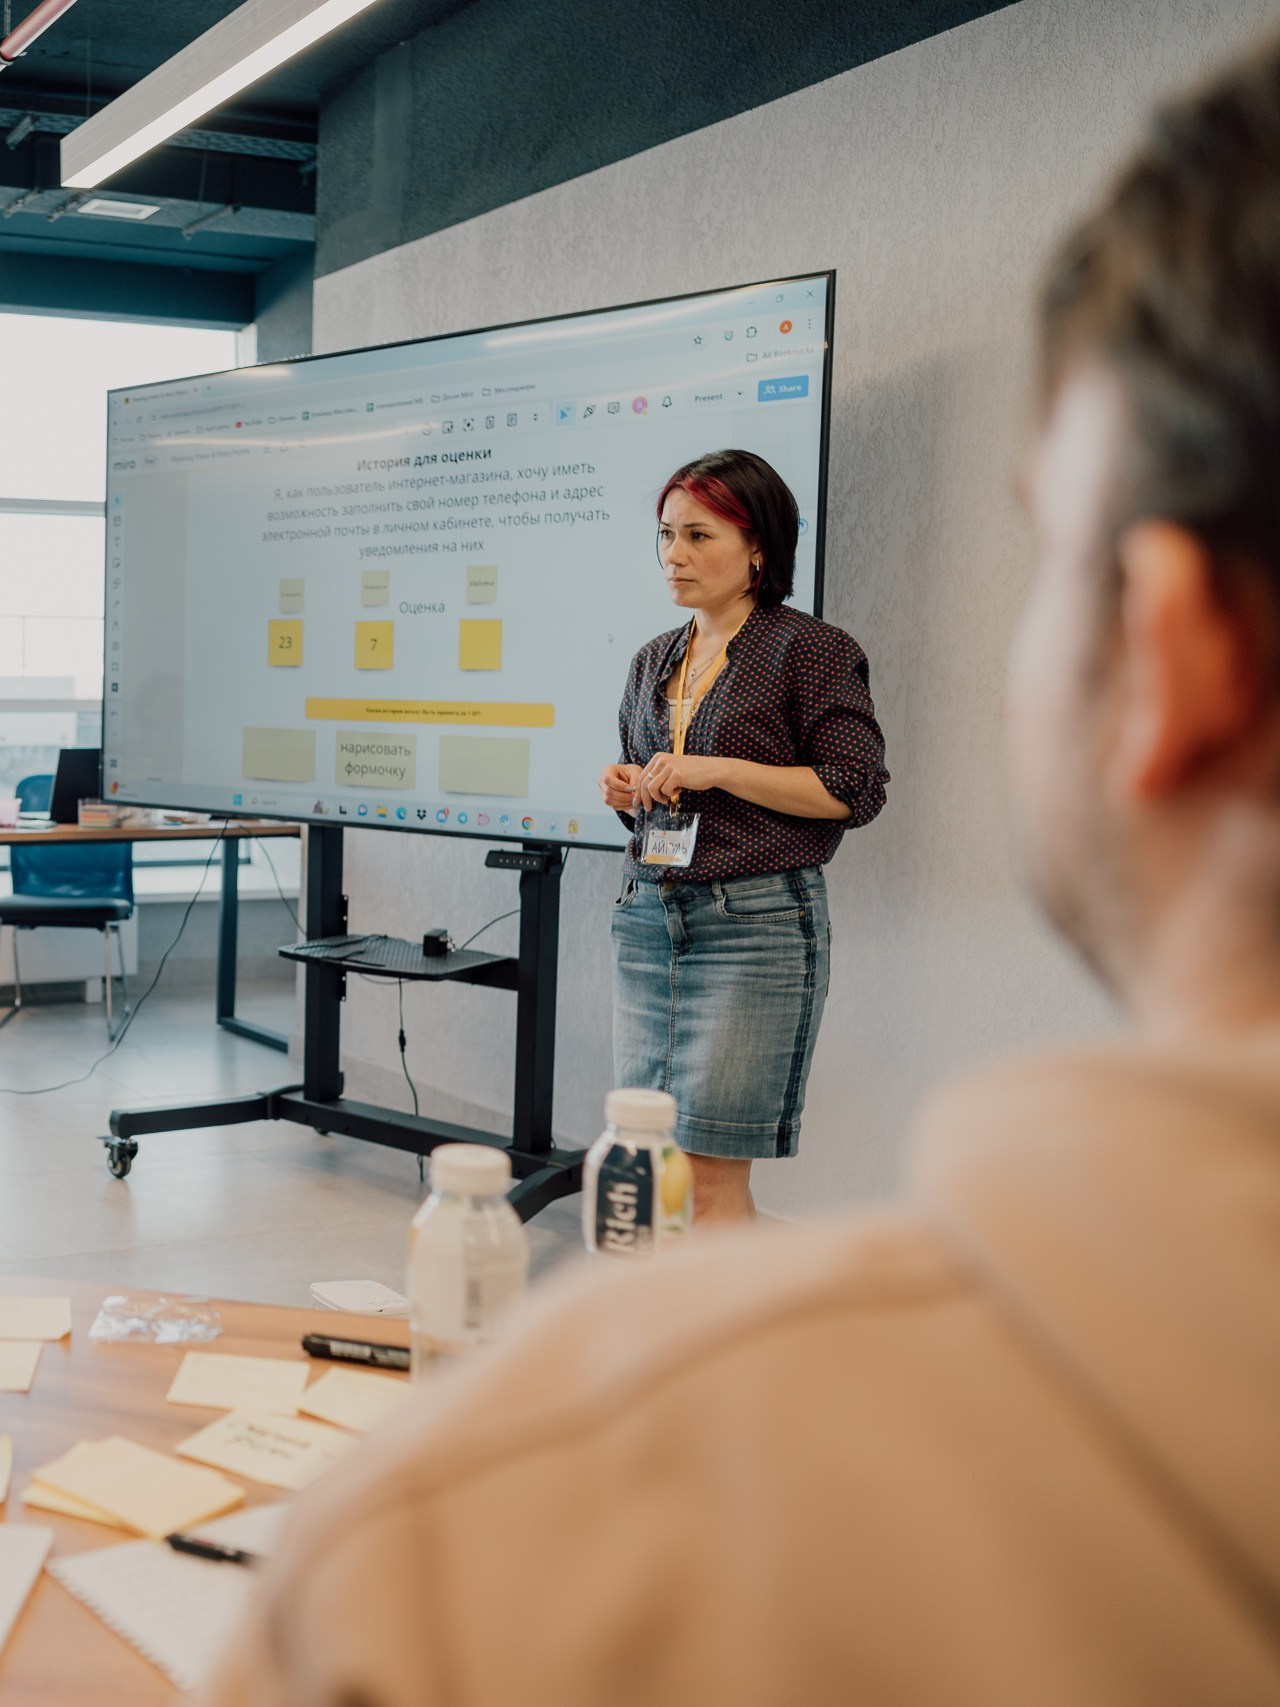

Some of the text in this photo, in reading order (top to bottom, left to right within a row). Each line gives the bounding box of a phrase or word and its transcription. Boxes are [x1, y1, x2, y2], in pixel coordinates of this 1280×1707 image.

[695, 392, 723, 403] Present
[779, 383, 802, 394] Share
[113, 459, 136, 470] miro
[357, 448, 492, 472] История для оценки
[286, 487, 304, 499] как
[306, 480, 385, 498] пользователь
[388, 470, 513, 491] интернет-магазина,
[517, 466, 549, 482] хочу
[552, 461, 595, 477] иметь
[267, 485, 604, 522] возможность заполнить свой номер телефона и адрес
[262, 508, 610, 543] электронной почты в личном кабинете, чтобы получать
[359, 540, 485, 561] уведомления на них
[399, 601, 445, 616] Оценка
[278, 636, 292, 649] 23
[370, 638, 378, 651] 7
[340, 741, 412, 757] нарисовать
[344, 760, 406, 781] формочку
[605, 1181, 639, 1253] Rich
